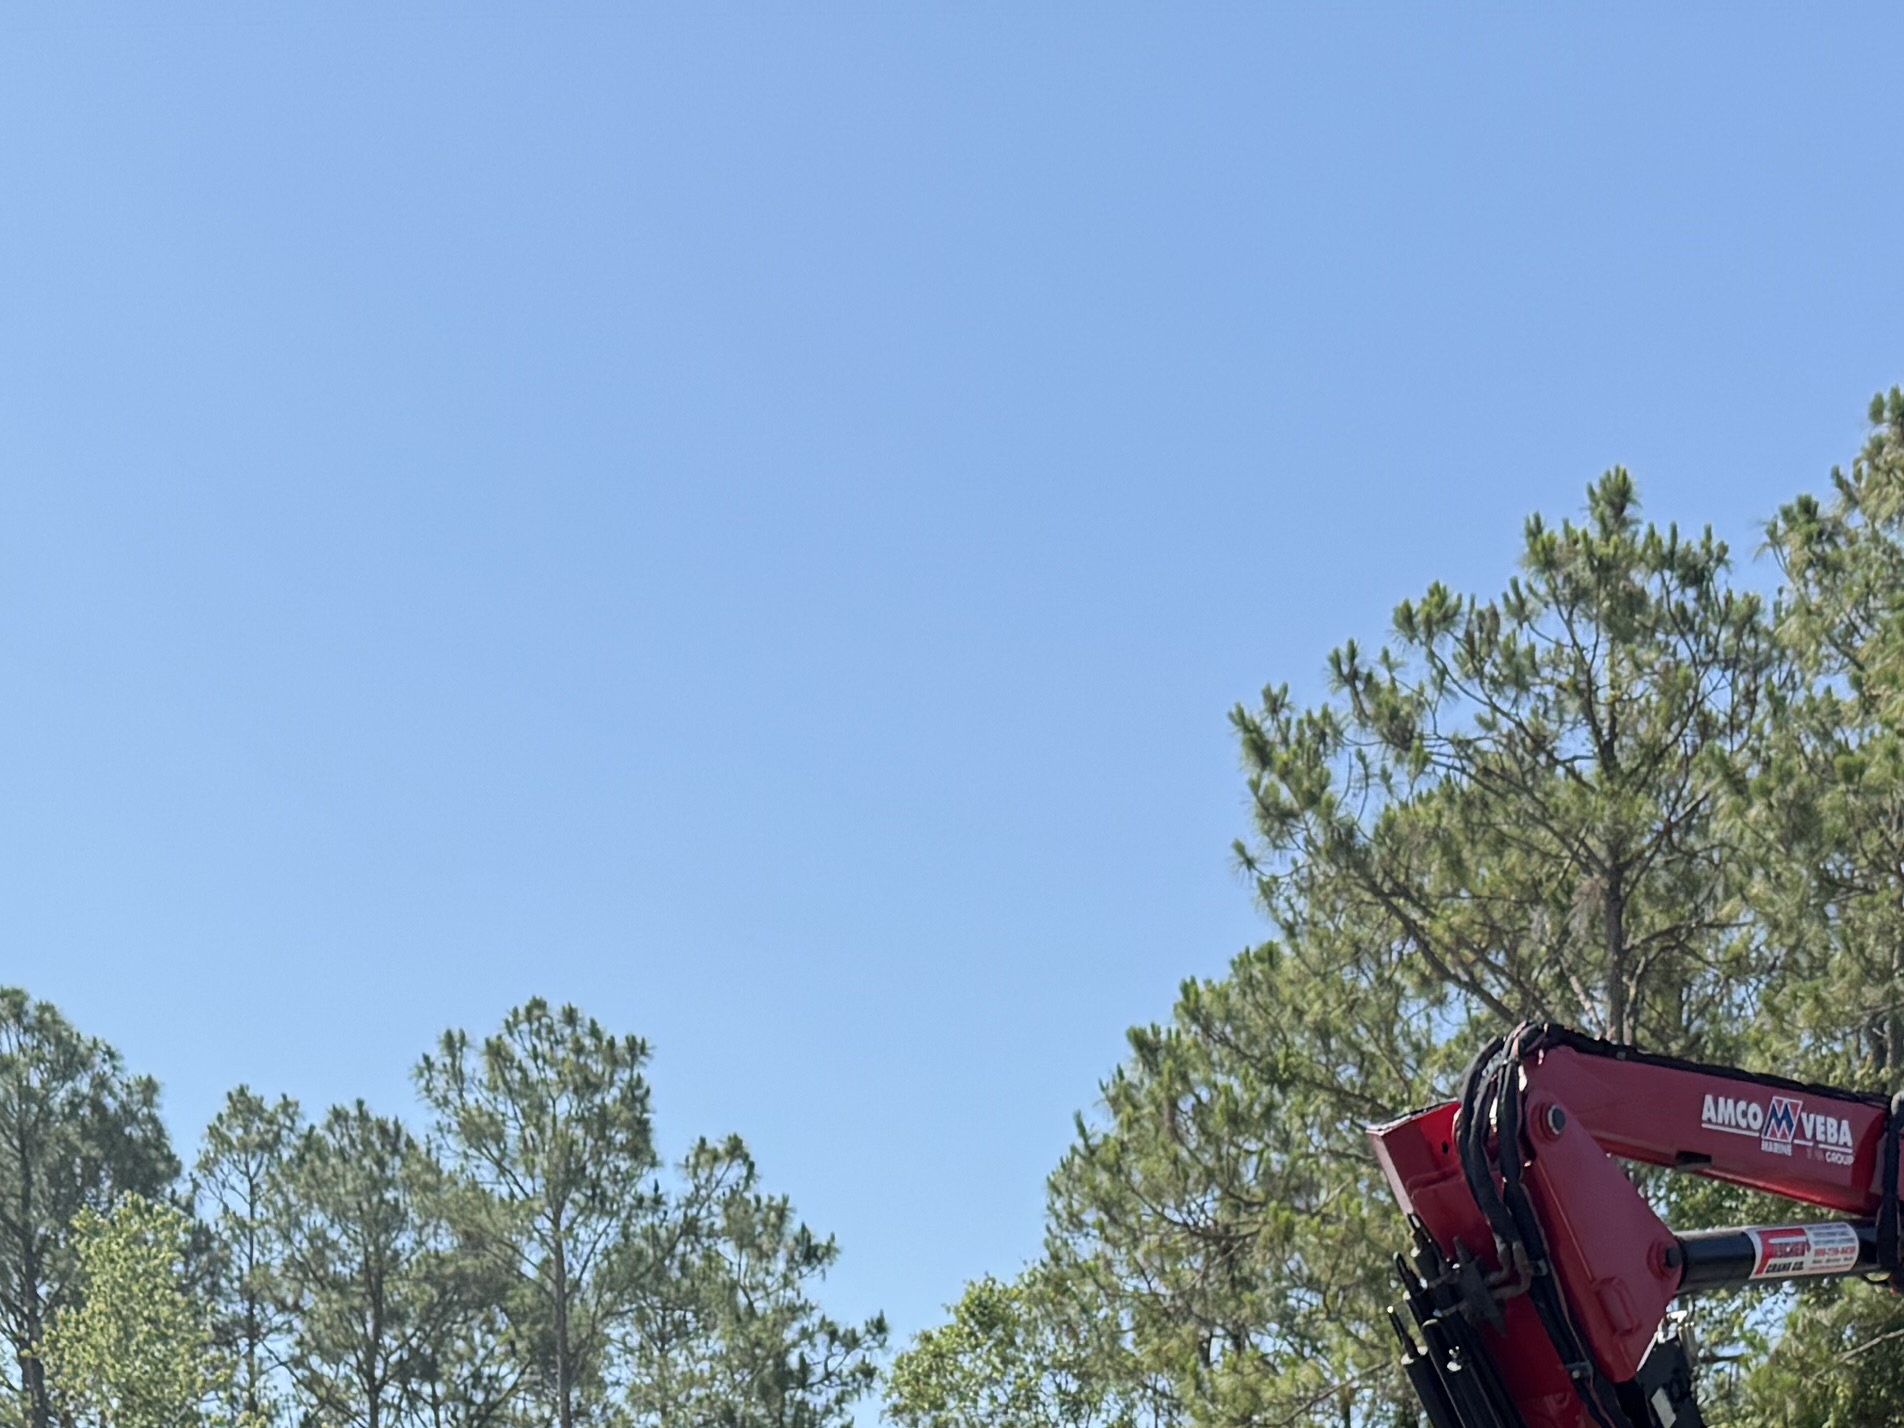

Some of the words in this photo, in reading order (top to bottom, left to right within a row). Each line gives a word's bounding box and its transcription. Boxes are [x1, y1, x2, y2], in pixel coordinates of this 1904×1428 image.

[1701, 1094, 1764, 1131] AMCO
[1800, 1112, 1854, 1148] VEBA
[1825, 1151, 1855, 1166] GROUP
